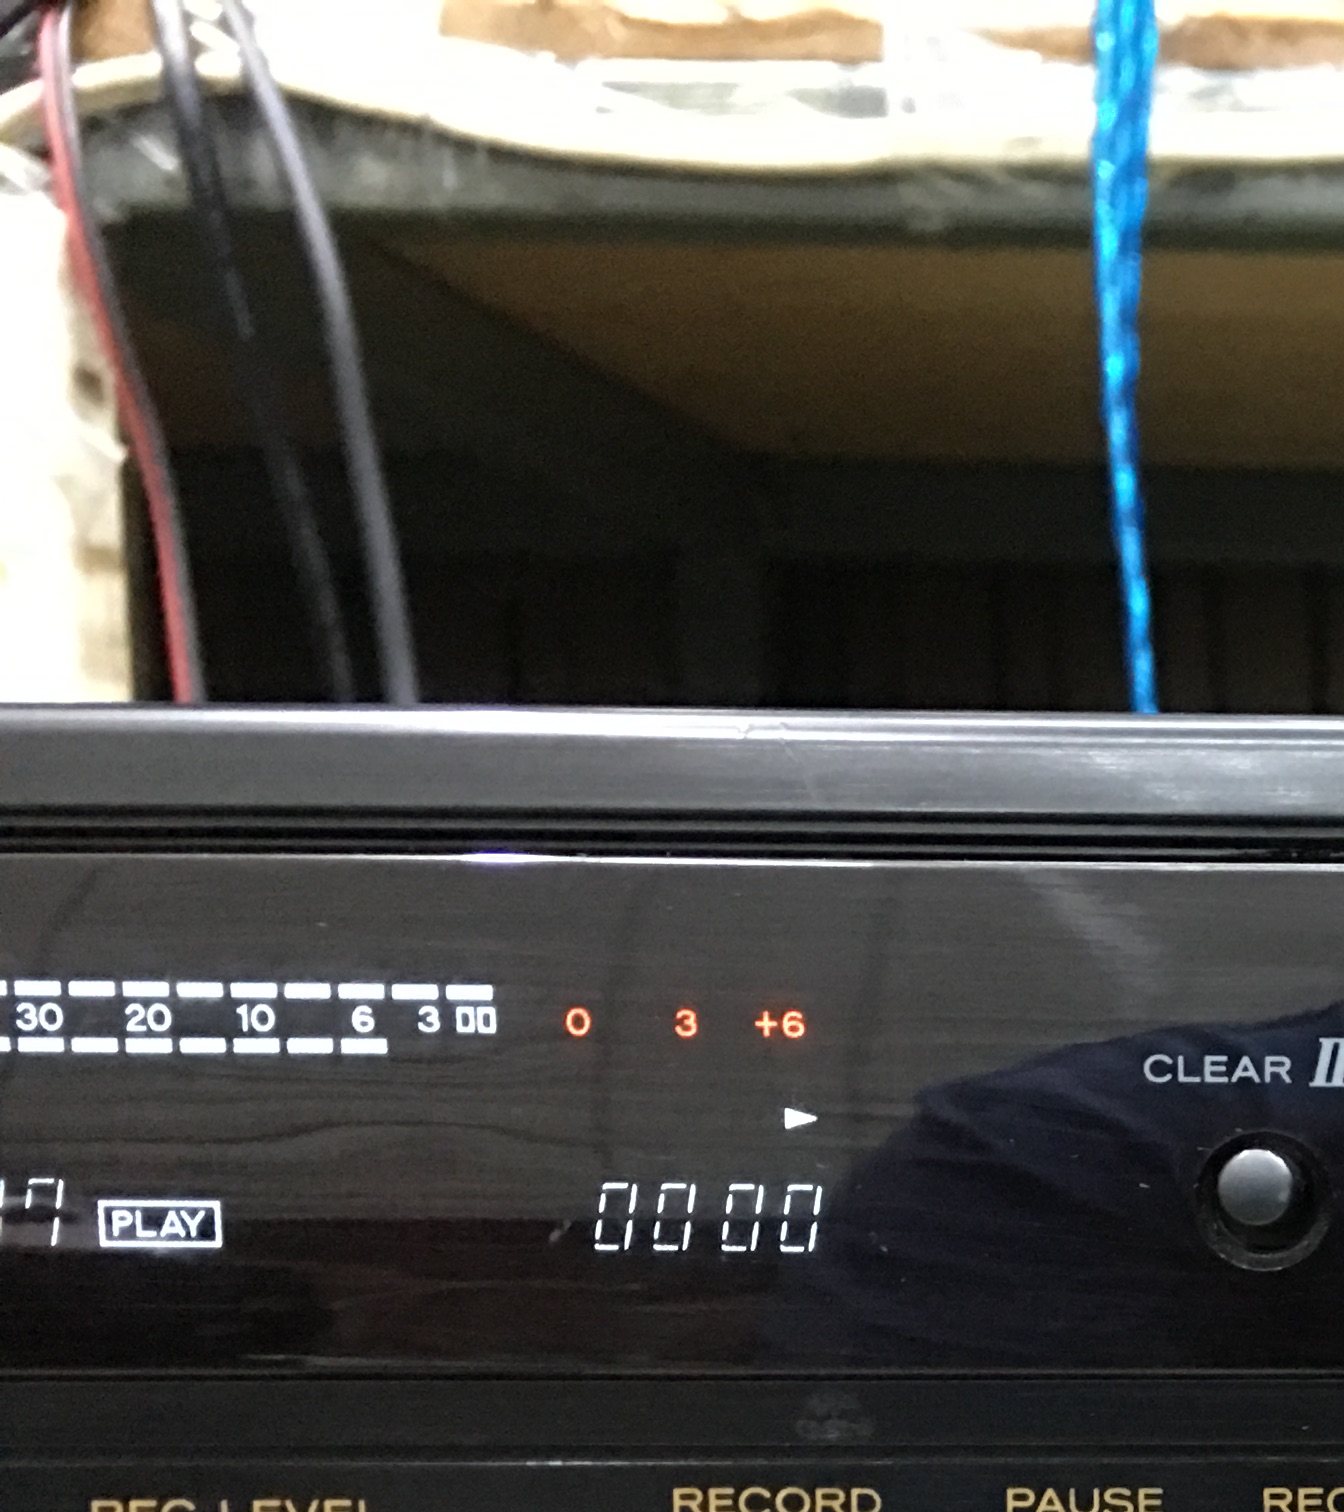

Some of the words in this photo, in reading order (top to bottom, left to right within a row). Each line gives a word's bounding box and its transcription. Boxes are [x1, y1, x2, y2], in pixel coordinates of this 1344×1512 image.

[15, 1001, 64, 1034] 30
[124, 1002, 173, 1033] 20
[235, 1003, 276, 1033] 10
[351, 1004, 376, 1034] 6
[417, 1004, 441, 1034] 3
[565, 1007, 592, 1037] 0
[674, 1008, 699, 1039] 3
[754, 1009, 807, 1039] +6
[1143, 1054, 1292, 1084] CLEAR
[111, 1209, 206, 1238] PLAY
